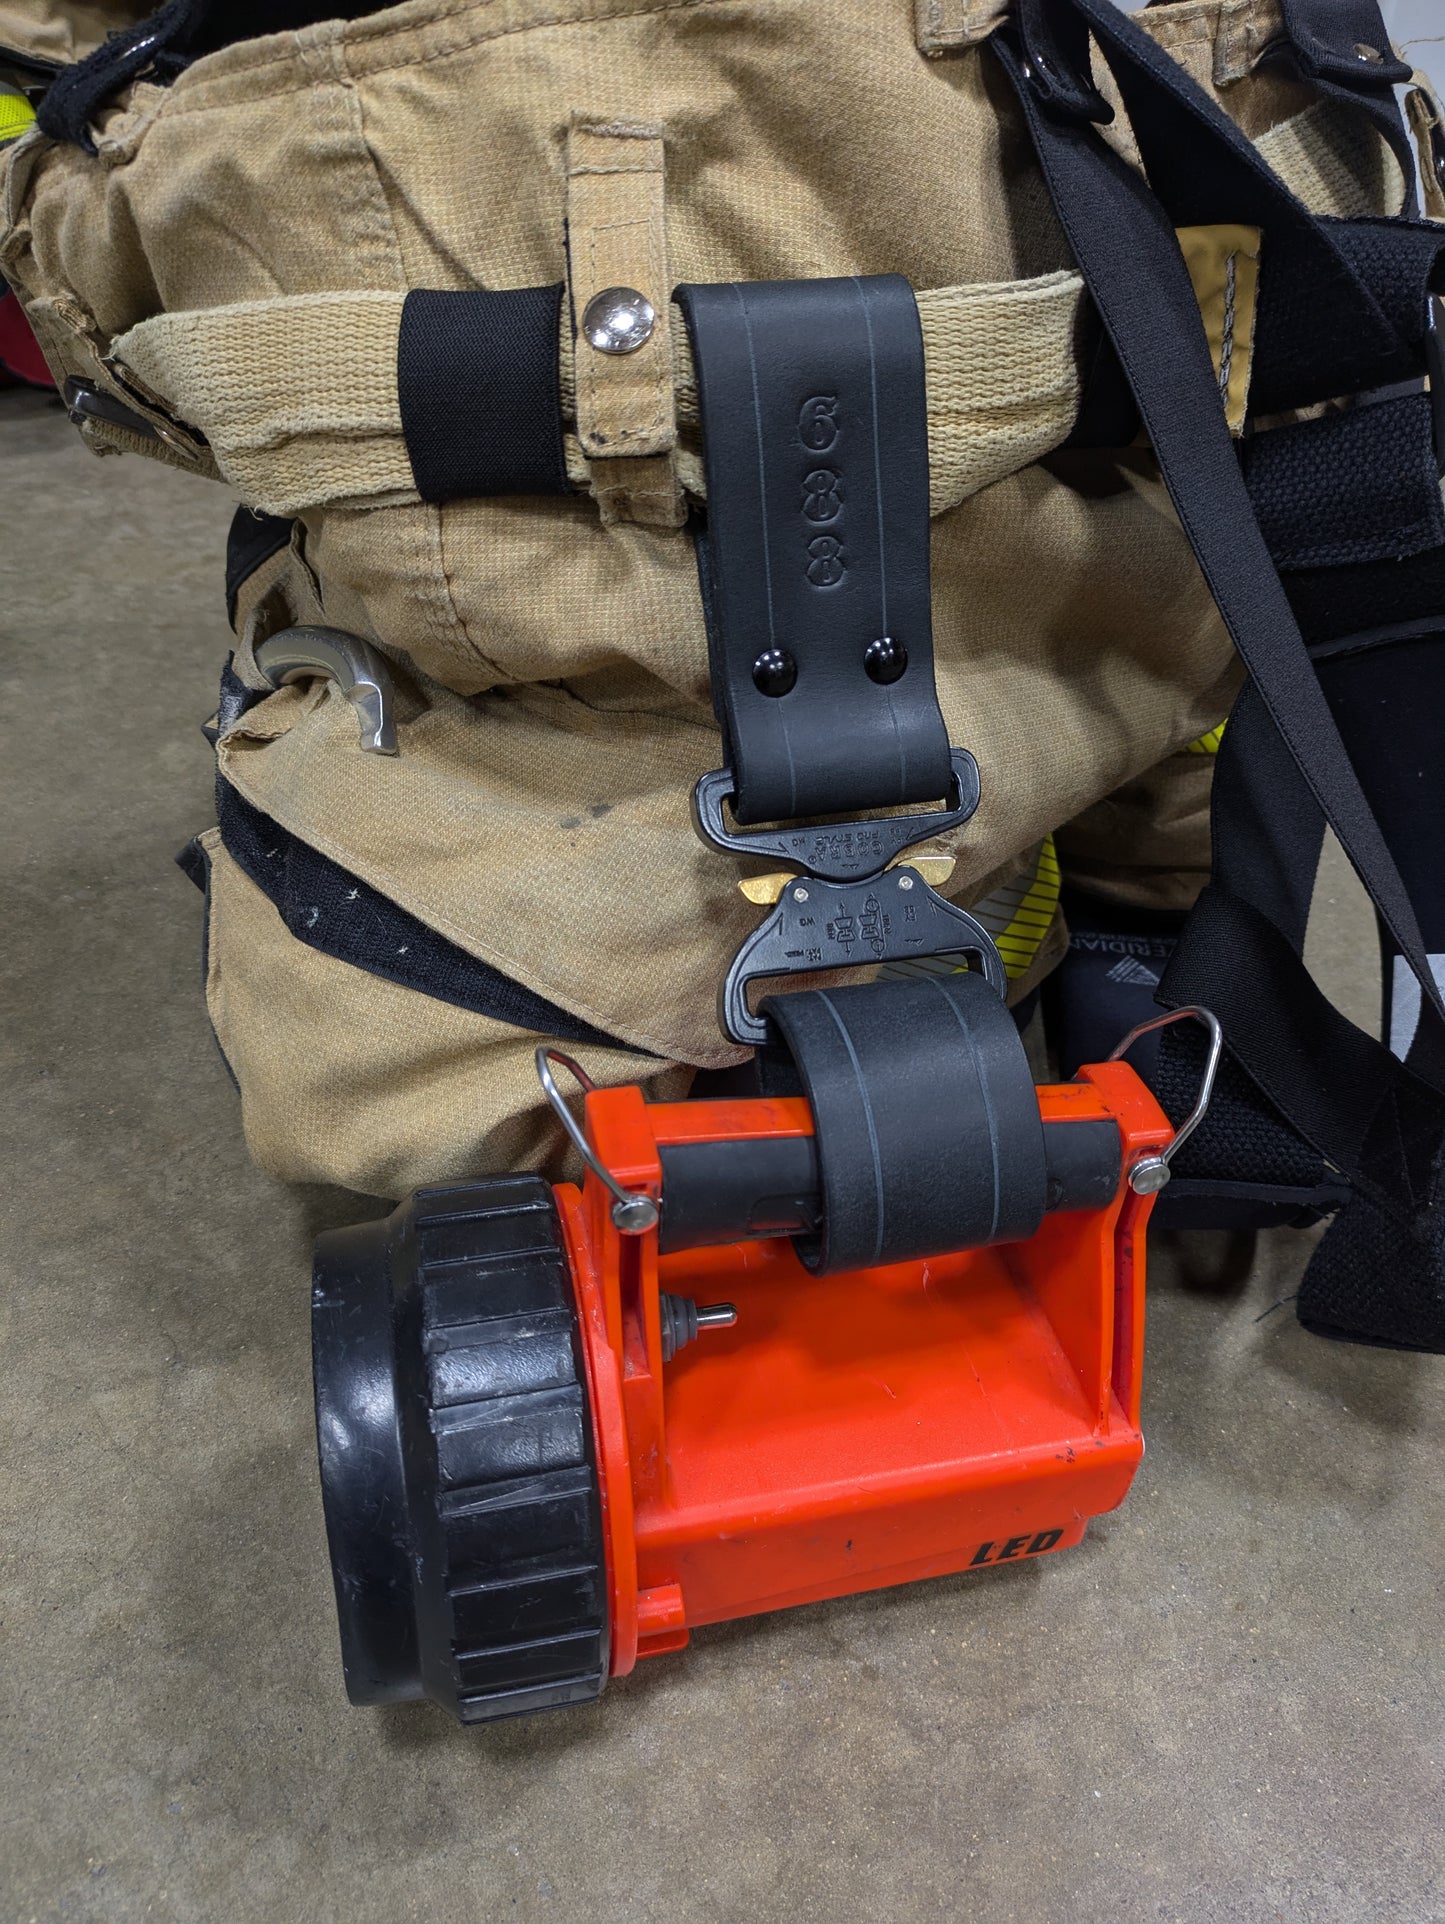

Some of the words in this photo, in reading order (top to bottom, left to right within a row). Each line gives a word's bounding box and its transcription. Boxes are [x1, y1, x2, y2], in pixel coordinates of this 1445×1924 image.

[815, 833, 855, 846] STYLE
[856, 831, 880, 841] PRO
[815, 840, 884, 861] COBRA
[1069, 938, 1174, 958] ERIDIAN
[969, 1529, 1064, 1566] LED
